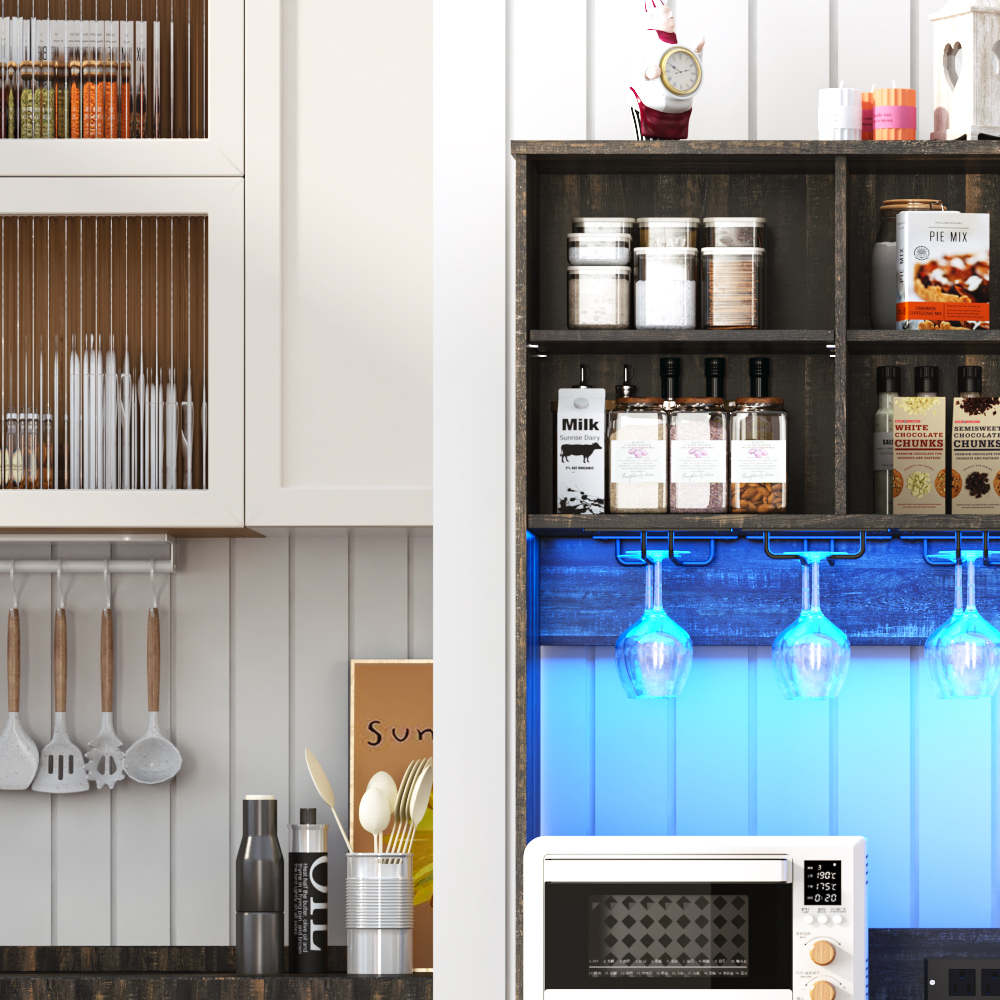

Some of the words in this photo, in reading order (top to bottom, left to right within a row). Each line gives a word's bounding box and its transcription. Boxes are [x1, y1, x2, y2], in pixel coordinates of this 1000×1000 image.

[930, 230, 944, 242] PIE
[950, 232, 968, 242] MIX
[562, 418, 599, 430] Milk
[895, 440, 943, 448] CHUNKS
[368, 720, 433, 746] Sun
